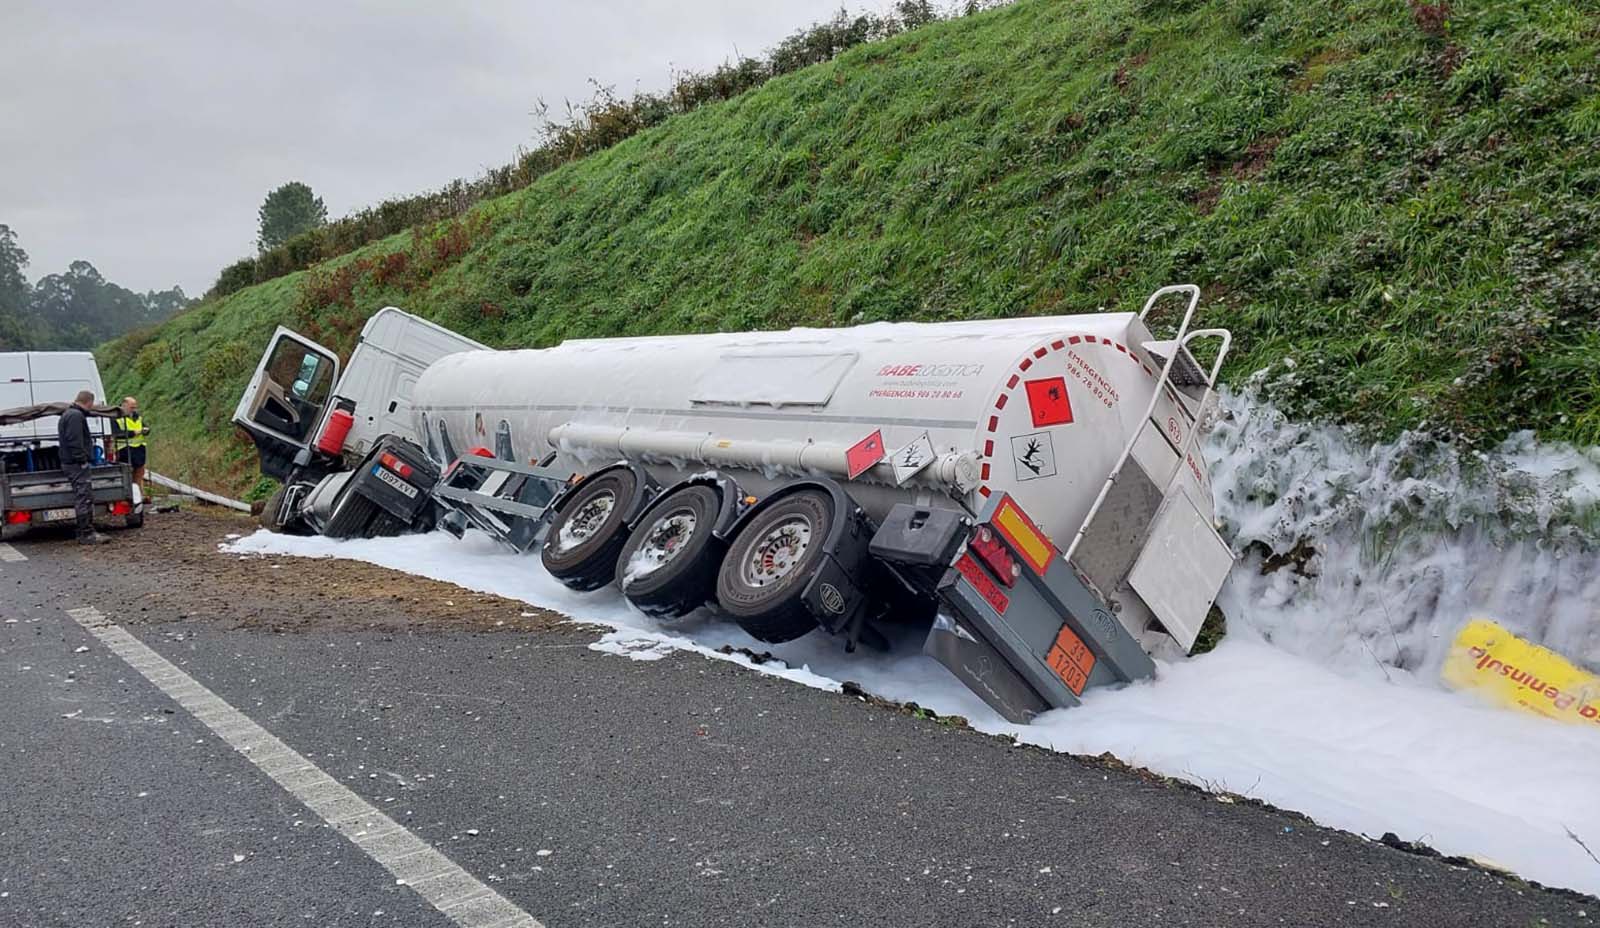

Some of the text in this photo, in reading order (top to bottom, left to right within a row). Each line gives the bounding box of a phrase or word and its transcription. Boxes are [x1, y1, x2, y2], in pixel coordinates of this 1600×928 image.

[1067, 362, 1112, 408] 986 28 80 68
[1068, 350, 1119, 401] EMERGENCIAS
[869, 390, 915, 398] EMERGENCIAS
[379, 470, 399, 485] 1097
[1070, 640, 1085, 662] 33
[1055, 653, 1081, 689] 1203
